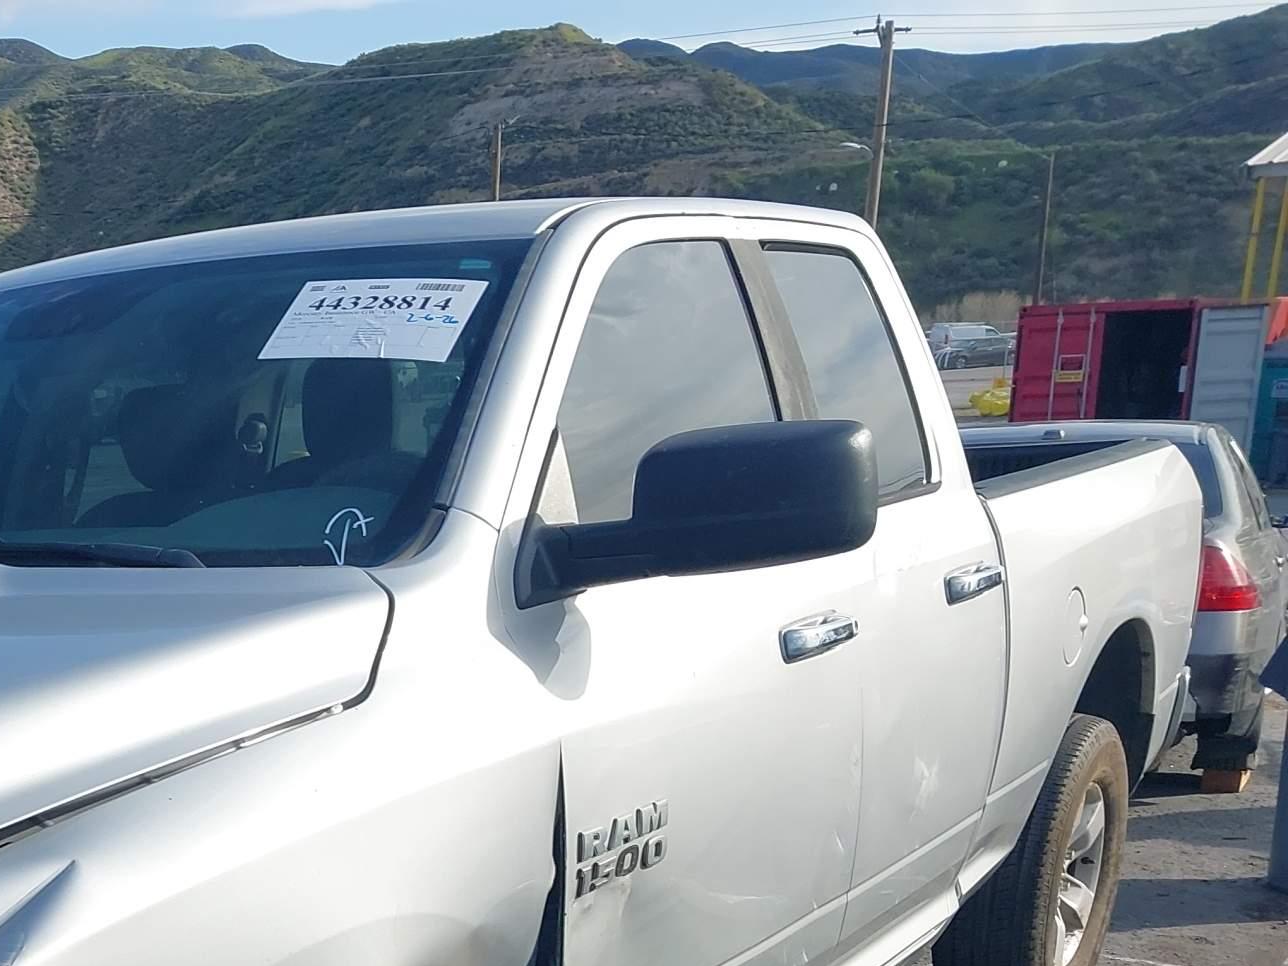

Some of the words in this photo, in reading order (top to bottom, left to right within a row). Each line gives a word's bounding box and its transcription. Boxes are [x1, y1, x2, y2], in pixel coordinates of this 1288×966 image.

[309, 295, 453, 311] 44328814
[406, 312, 459, 324] 2-6-26
[577, 799, 669, 864] RAM
[575, 835, 668, 899] 1500
